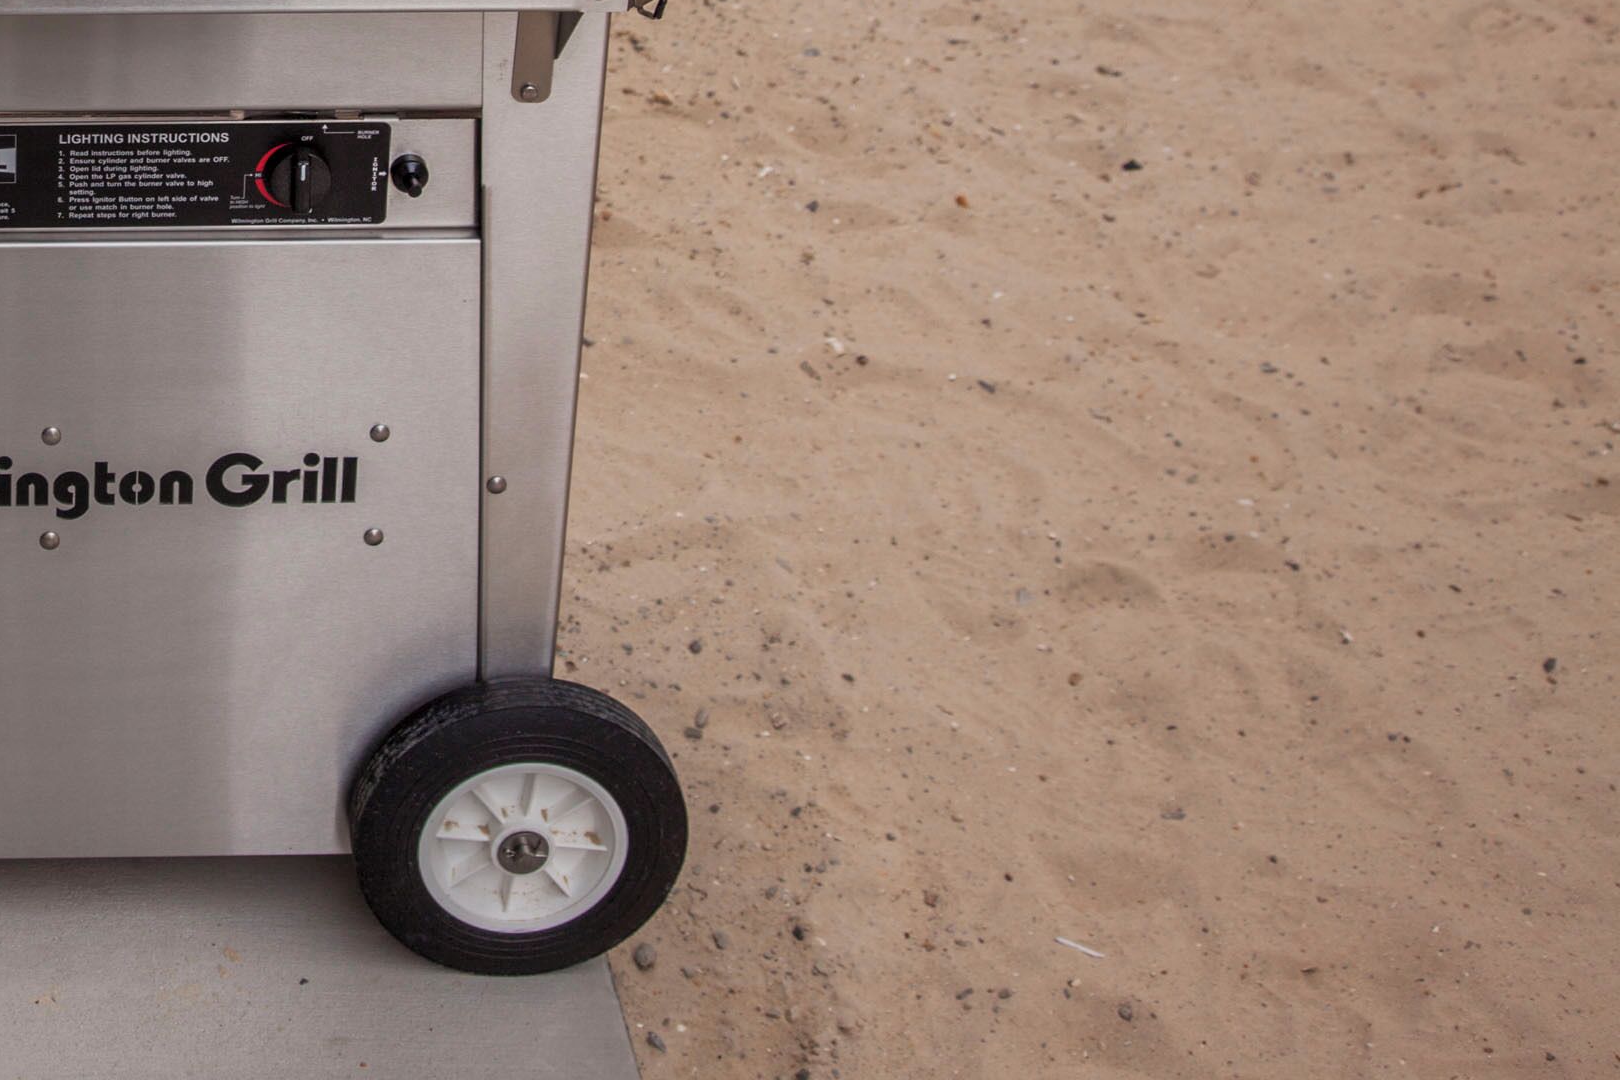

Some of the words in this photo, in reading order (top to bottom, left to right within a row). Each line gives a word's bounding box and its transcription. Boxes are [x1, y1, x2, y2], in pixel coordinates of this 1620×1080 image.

[59, 133, 124, 144] LIGHTING
[128, 132, 230, 144] INSTRUCTIONS
[205, 451, 358, 506] Grill
